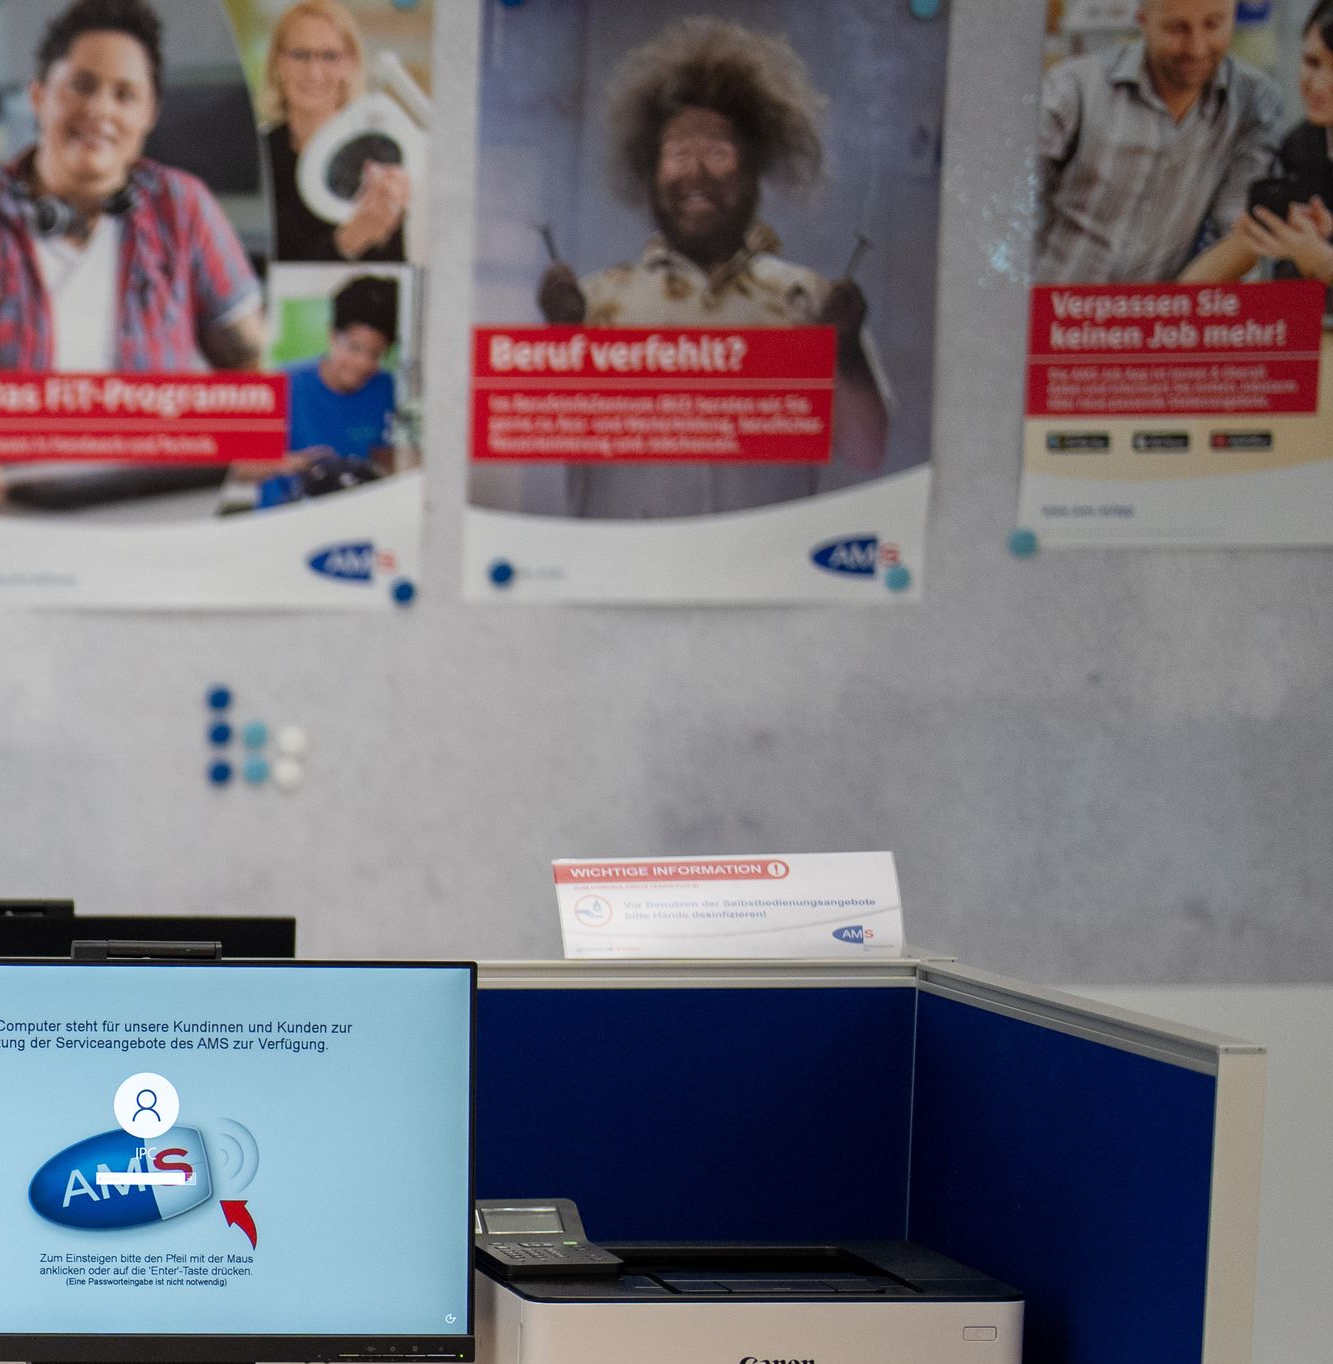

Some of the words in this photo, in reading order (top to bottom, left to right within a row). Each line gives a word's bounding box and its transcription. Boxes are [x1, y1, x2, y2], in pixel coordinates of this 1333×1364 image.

[1050, 291, 1191, 321] Verpassen
[1197, 289, 1240, 316] Sie
[1050, 321, 1142, 349] keinen
[1147, 321, 1198, 348] Job
[1203, 318, 1287, 346] mehr!
[490, 334, 586, 371] Beruf
[590, 334, 747, 372] verfehlt?
[570, 866, 649, 879] WICHTIGE
[652, 864, 762, 877] INFORMATION
[701, 900, 719, 908] der
[723, 899, 876, 908] Selbstbedienungsangebote
[842, 929, 874, 940] AMS
[65, 1020, 97, 1032] steht
[102, 1020, 120, 1032] für
[124, 1023, 169, 1033] unsere
[173, 1020, 243, 1033] Kundinnen
[248, 1021, 272, 1033] und
[277, 1021, 327, 1034] Kunden
[331, 1024, 353, 1034] zur
[30, 1036, 51, 1049] der
[55, 1036, 166, 1052] Serviceangebote
[170, 1037, 194, 1049] des
[197, 1038, 229, 1050] AMS
[232, 1039, 254, 1050] zur
[258, 1037, 329, 1053] Verfügung.
[134, 1147, 157, 1160] IPC
[62, 1147, 194, 1208] AMS
[39, 1253, 63, 1263] Zum
[66, 1253, 118, 1265] Einsteigen
[120, 1253, 142, 1263] bitte
[144, 1253, 163, 1263] den
[166, 1253, 187, 1263] Pfeil
[190, 1254, 205, 1263] mit
[207, 1254, 223, 1263] der
[227, 1254, 254, 1263] Maus
[39, 1266, 85, 1275] anklicken
[88, 1266, 110, 1275] oder
[113, 1266, 129, 1275] auf
[132, 1266, 146, 1275] die
[148, 1266, 209, 1276] 'Enter'-Taste
[211, 1266, 253, 1276] drücken.
[66, 1278, 86, 1287] (Eine
[88, 1278, 154, 1287] Passworteingabe
[155, 1278, 165, 1286] ist
[166, 1278, 184, 1286] nicht
[186, 1278, 228, 1288] notwendig)
